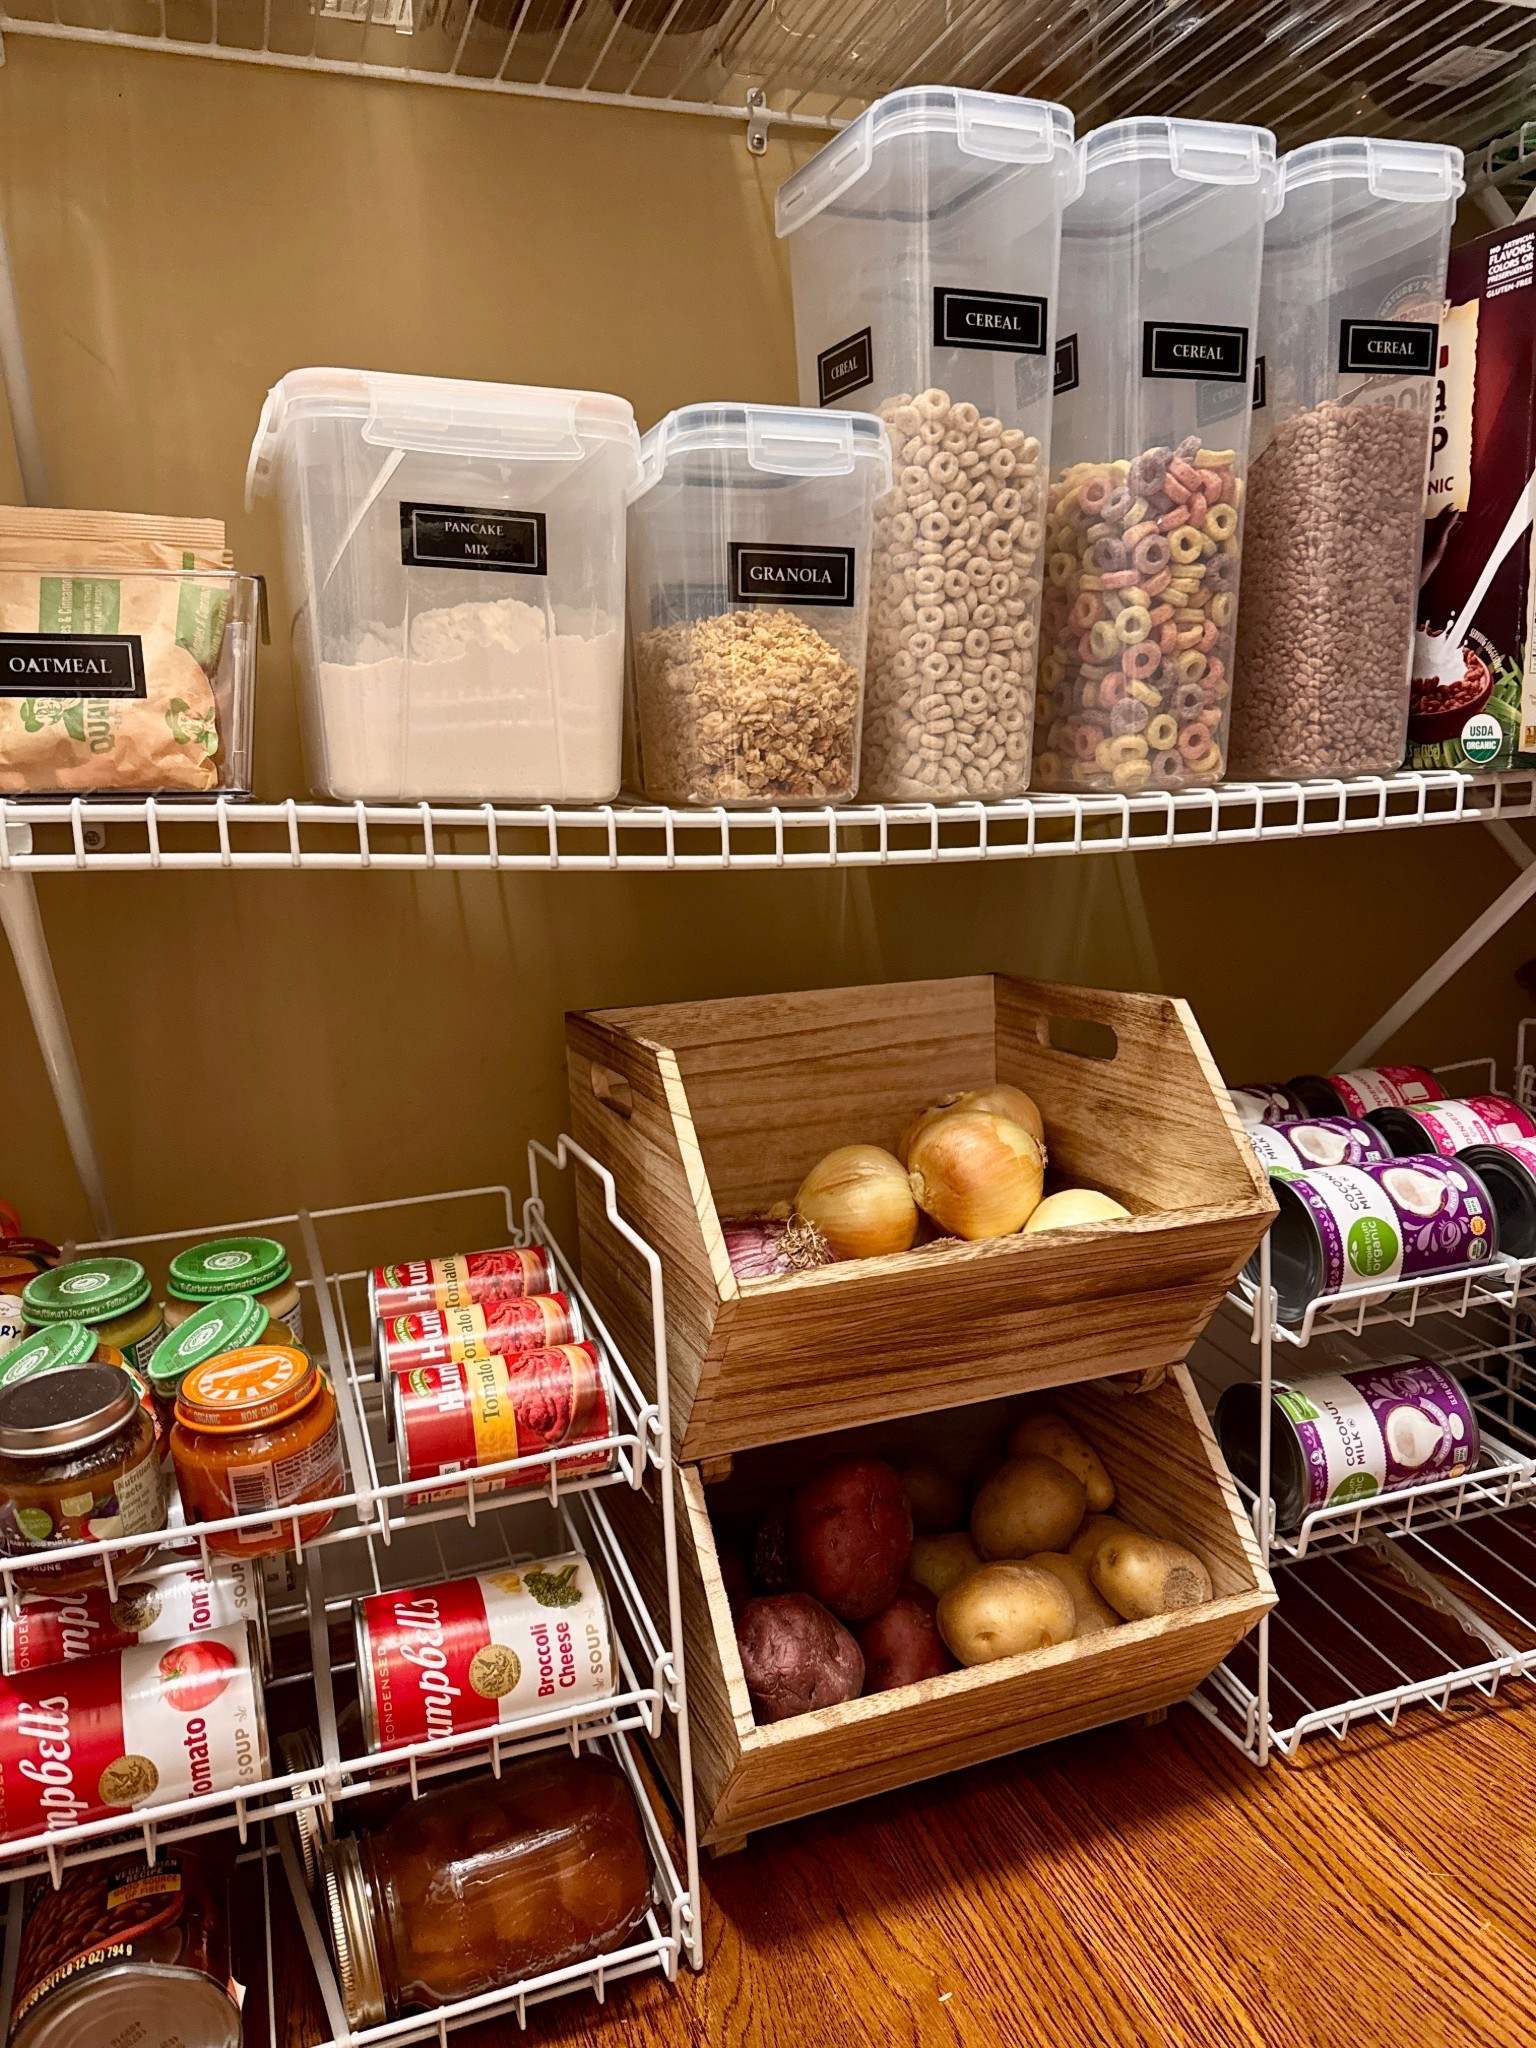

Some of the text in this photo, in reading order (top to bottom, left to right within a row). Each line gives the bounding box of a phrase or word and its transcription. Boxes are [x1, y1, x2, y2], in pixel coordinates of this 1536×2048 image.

[1489, 241, 1534, 265] FLAVORS,
[1490, 233, 1535, 255] NO ARTIFICIAL
[1487, 263, 1533, 284] PRESERVATIVES
[1488, 253, 1534, 276] COLORS OR
[1486, 277, 1533, 298] GLUTEN-FREE
[965, 312, 1022, 331] CEREAL
[1172, 344, 1224, 360] CEREAL
[1367, 340, 1414, 355] CEREAL
[830, 356, 858, 380] CEREAL
[444, 521, 504, 537] PANCAKE
[464, 542, 489, 556] MIX
[749, 566, 833, 584] GRANOLA
[9, 657, 113, 675] OATMEAL
[87, 698, 116, 755] QUA
[1470, 725, 1494, 736] USDA
[1466, 741, 1497, 750] ORGANIC
[1445, 1111, 1472, 1145] DENSED
[1311, 1169, 1359, 1211] COCONUT
[1349, 1182, 1371, 1210] MILK
[1361, 1222, 1374, 1272] simple truth
[1368, 1220, 1383, 1271] organic
[442, 1263, 460, 1308] Tomato
[457, 1314, 477, 1361] omato
[477, 1363, 501, 1423] Tomato
[194, 1412, 221, 1424] ORGANIC
[1323, 1400, 1353, 1466] COCONUT
[1351, 1431, 1366, 1465] MILK
[1439, 1441, 1450, 1459] RICH
[117, 1462, 151, 1490] Nutrition
[119, 1482, 143, 1500] Facts
[26, 1540, 47, 1548] FOOD
[26, 1563, 62, 1572] PRUNE
[231, 1563, 248, 1608] SOUP
[19, 1605, 30, 1668] ONDENS
[585, 1623, 604, 1675] SOUP
[530, 1623, 555, 1698] Broccoli
[555, 1621, 576, 1688] Cheese
[394, 1597, 461, 1741] ampbell's
[377, 1646, 396, 1742] CONDENSED
[19, 1696, 89, 1831] mpbell's
[184, 1717, 212, 1798] omato
[235, 1728, 254, 1777] SOUP
[113, 1875, 177, 1897] GOOD SOURCE
[126, 1867, 163, 1882] RECIPE
[125, 1884, 166, 1900] OF FIBER
[61, 1963, 73, 1979] LB
[75, 1957, 86, 1970] 12
[88, 1949, 105, 1966] OZ)
[107, 1944, 124, 1958] 794
[126, 1944, 133, 1956] g
